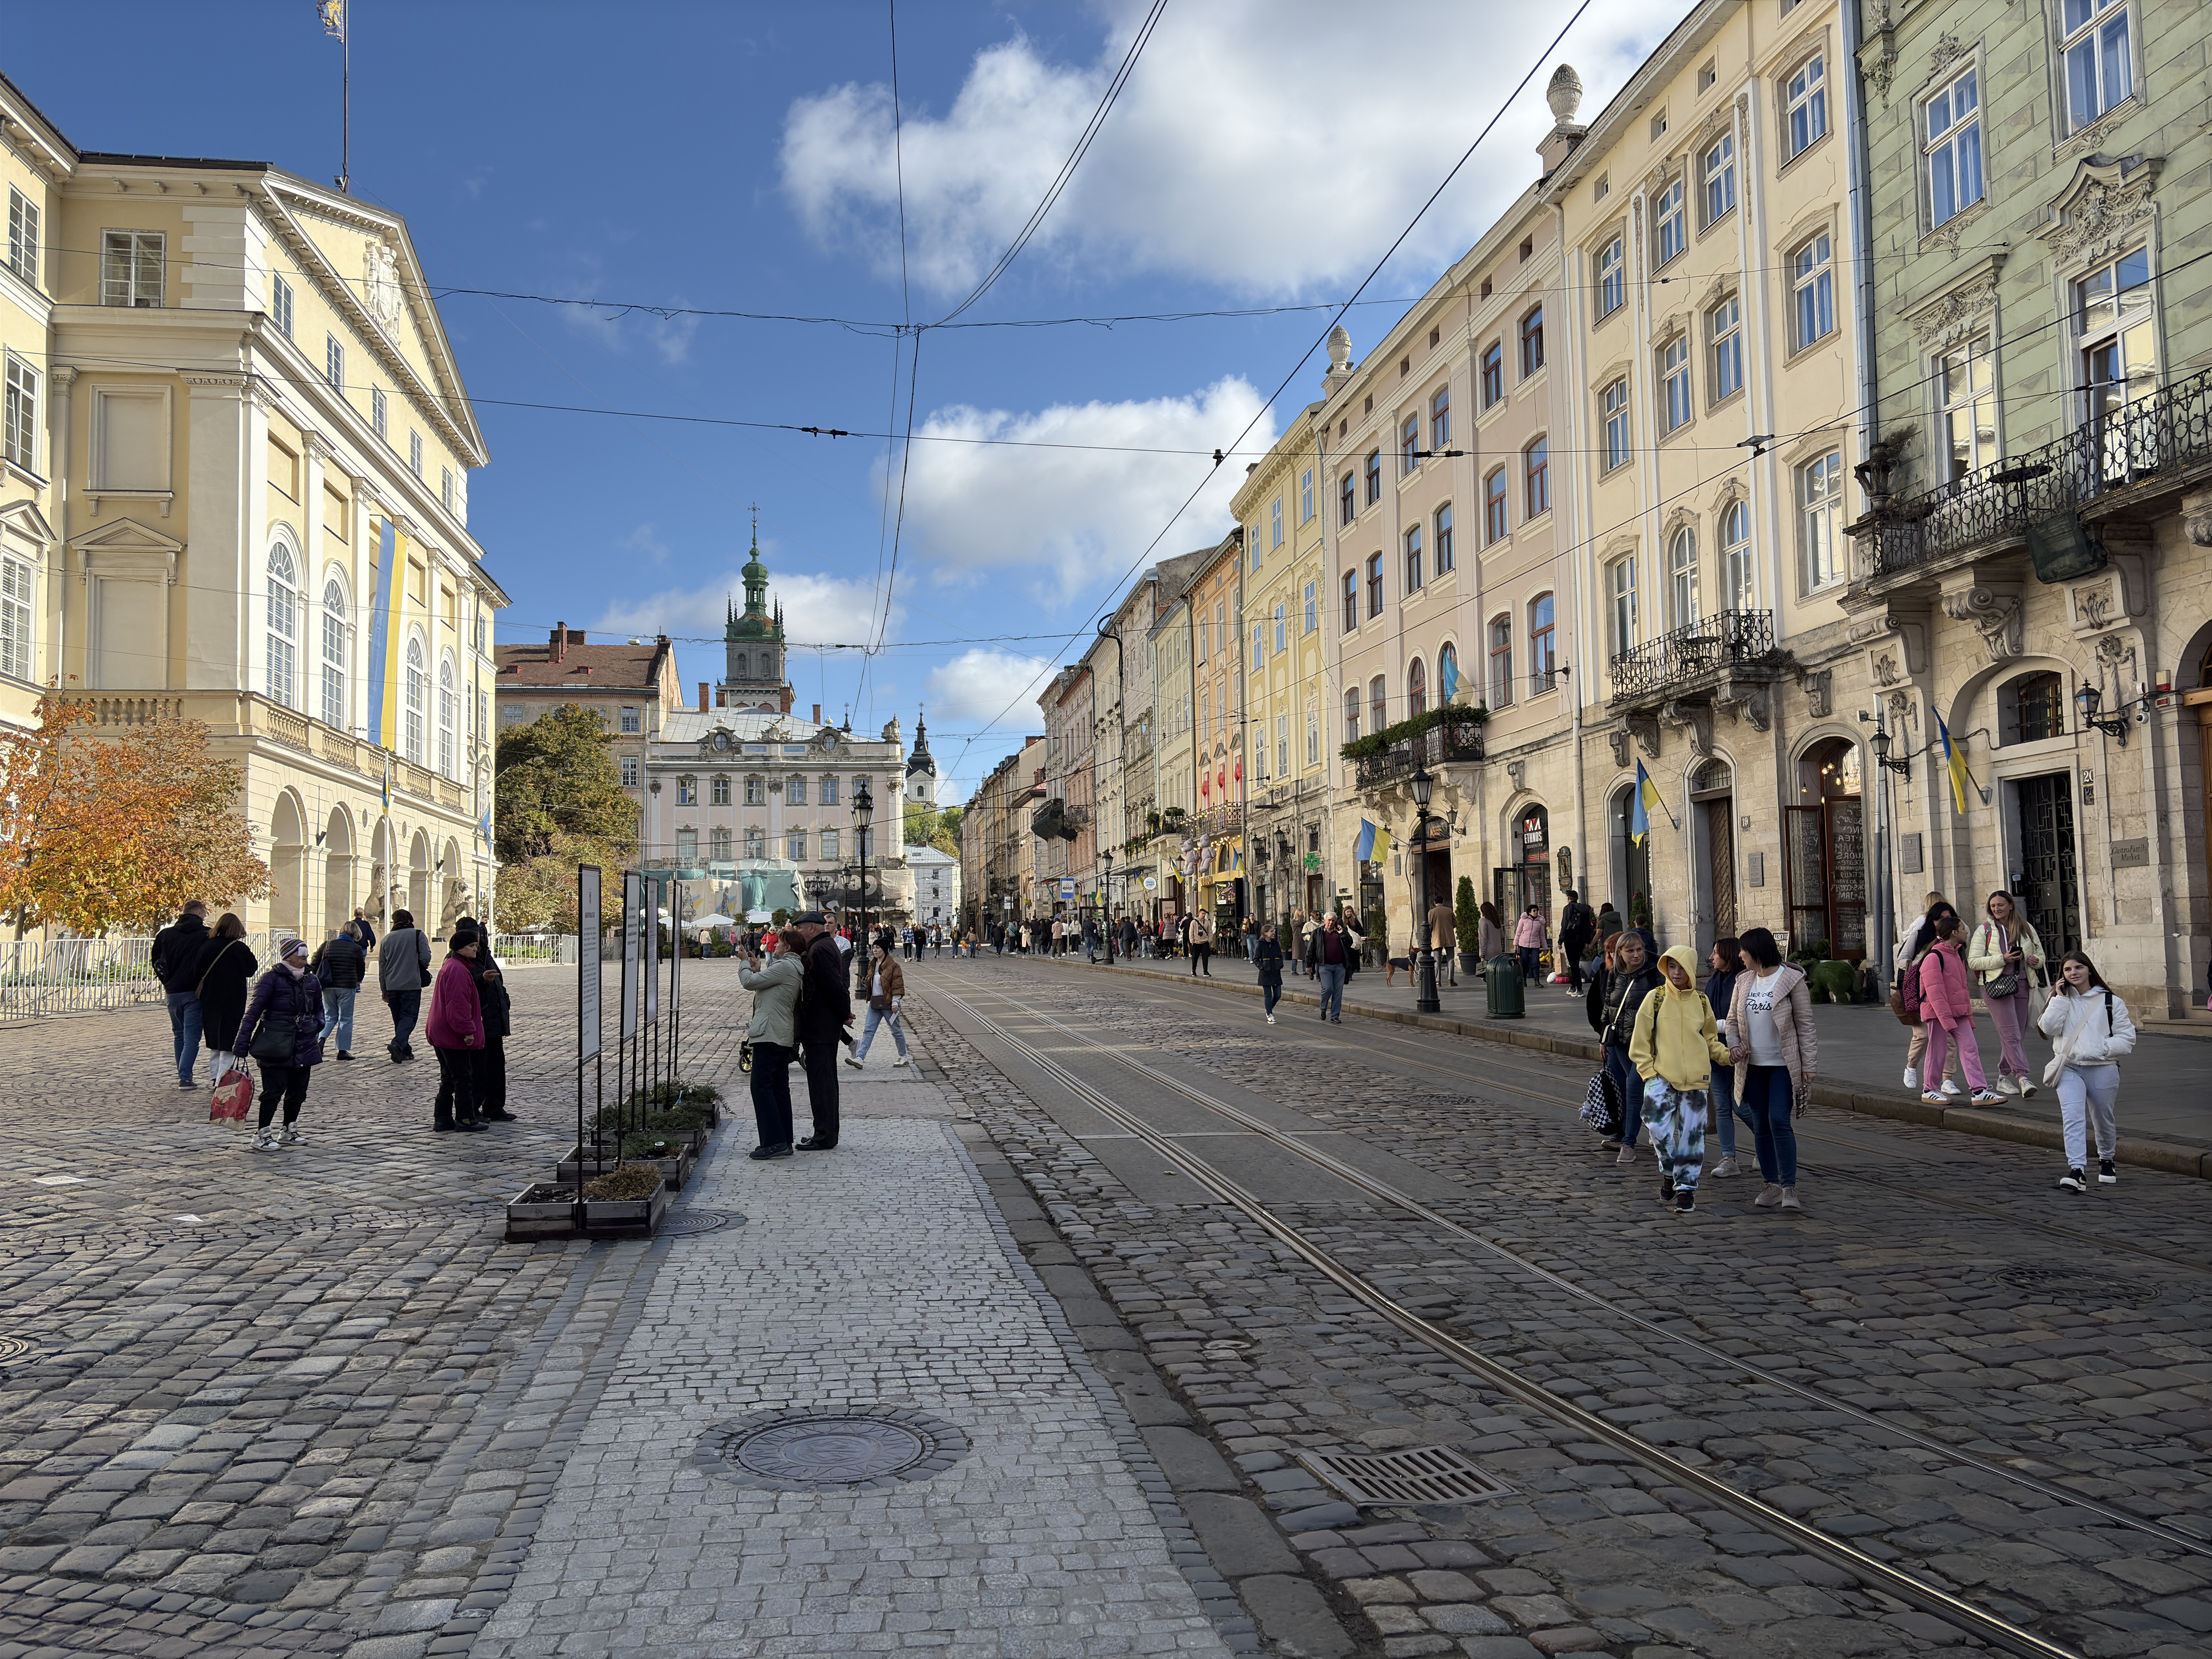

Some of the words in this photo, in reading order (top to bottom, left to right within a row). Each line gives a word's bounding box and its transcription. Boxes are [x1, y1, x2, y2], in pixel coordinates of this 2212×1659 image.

[1742, 817, 1748, 827] 19
[1524, 831, 1542, 844] ETHNOS
[1745, 998, 1772, 1011] Paris
